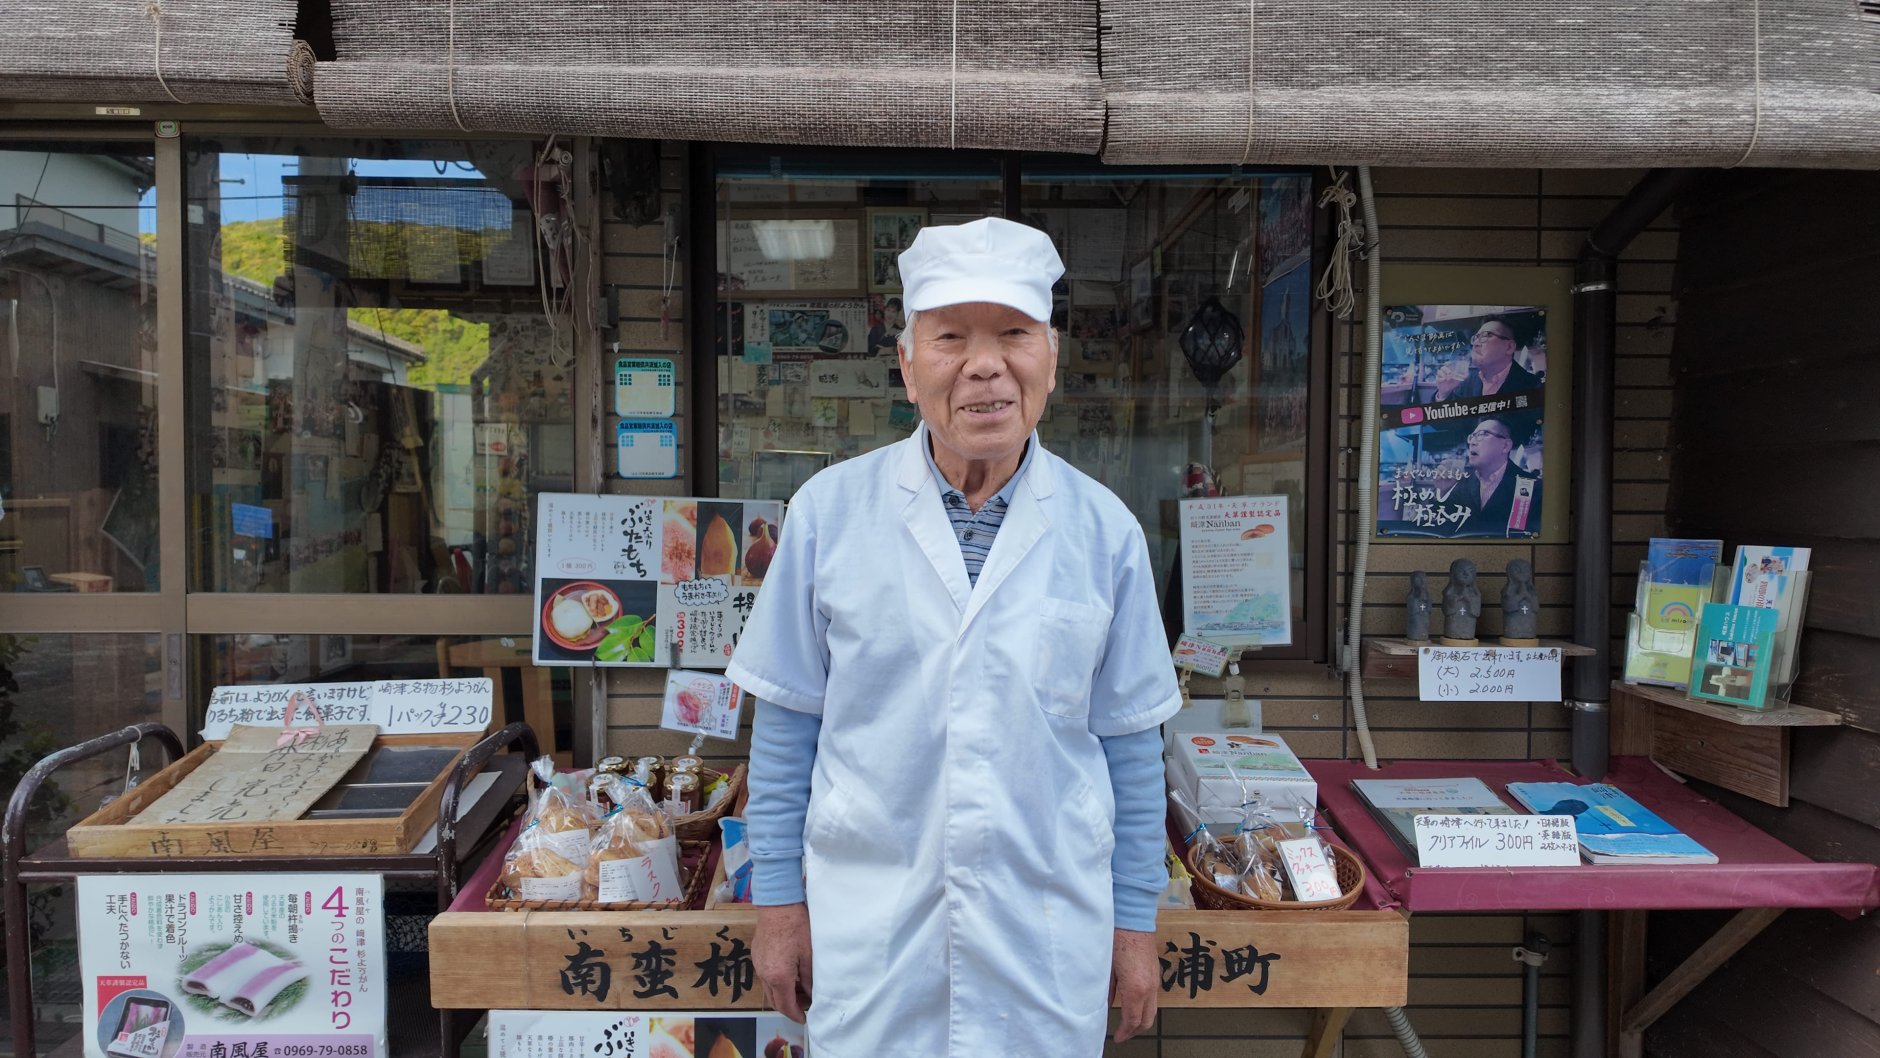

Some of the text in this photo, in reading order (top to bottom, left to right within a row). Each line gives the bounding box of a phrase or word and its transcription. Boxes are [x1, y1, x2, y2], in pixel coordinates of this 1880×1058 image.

[151, 827, 285, 857] 南風屋
[1496, 832, 1533, 851] 300円
[106, 894, 117, 915] 工夫
[165, 894, 176, 944] 果汁で着色
[117, 894, 131, 970] 手にべたつかない
[177, 894, 188, 962] ドラゴンフルーツ
[568, 925, 730, 942] いちじく
[559, 938, 753, 1003] 南蛮柿
[1158, 931, 1281, 999] 浦町
[210, 1040, 368, 1058] 南風屋 0969-79-0858
